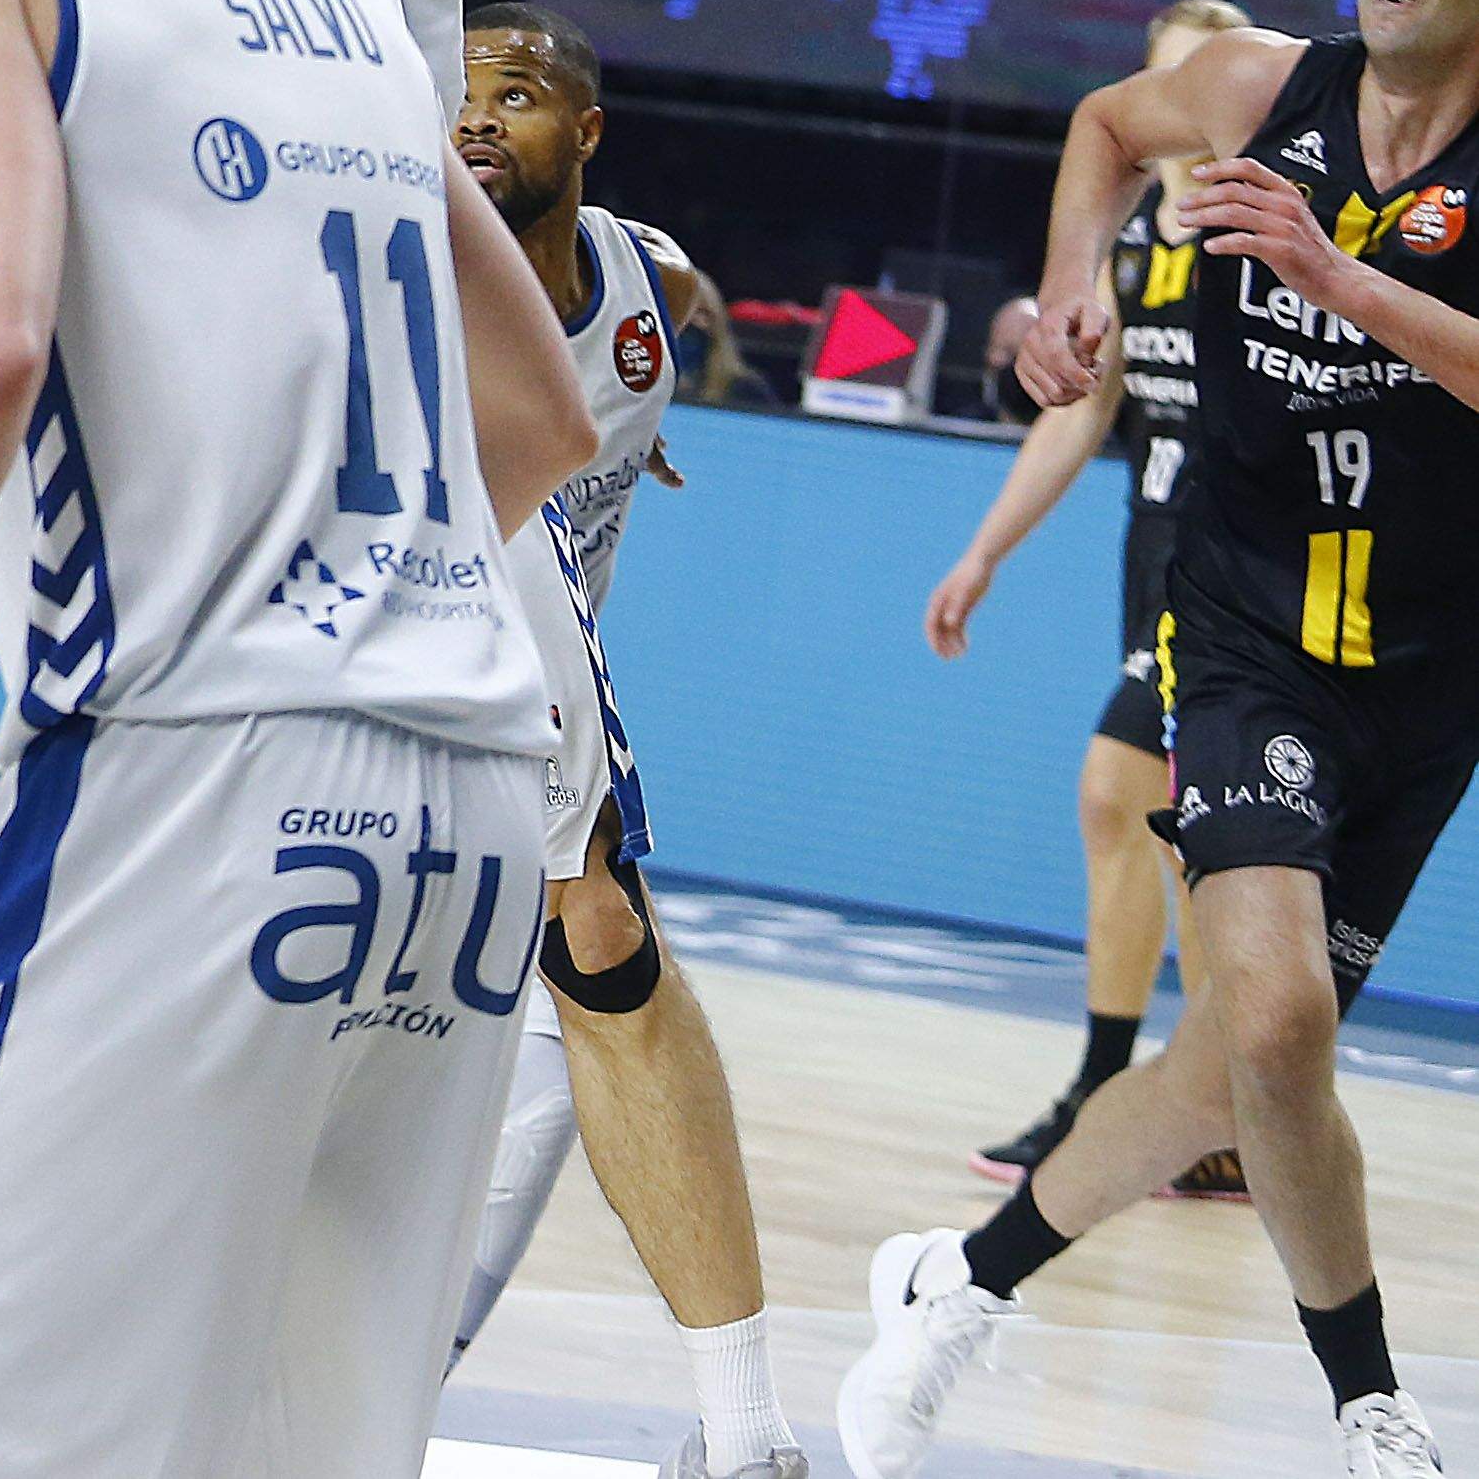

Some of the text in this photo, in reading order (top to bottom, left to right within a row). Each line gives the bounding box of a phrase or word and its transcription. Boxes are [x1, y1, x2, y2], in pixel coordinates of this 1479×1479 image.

[276, 139, 377, 179] GRUPO
[318, 209, 451, 525] 11
[1307, 428, 1372, 509] 19
[280, 807, 398, 839] GRUPO
